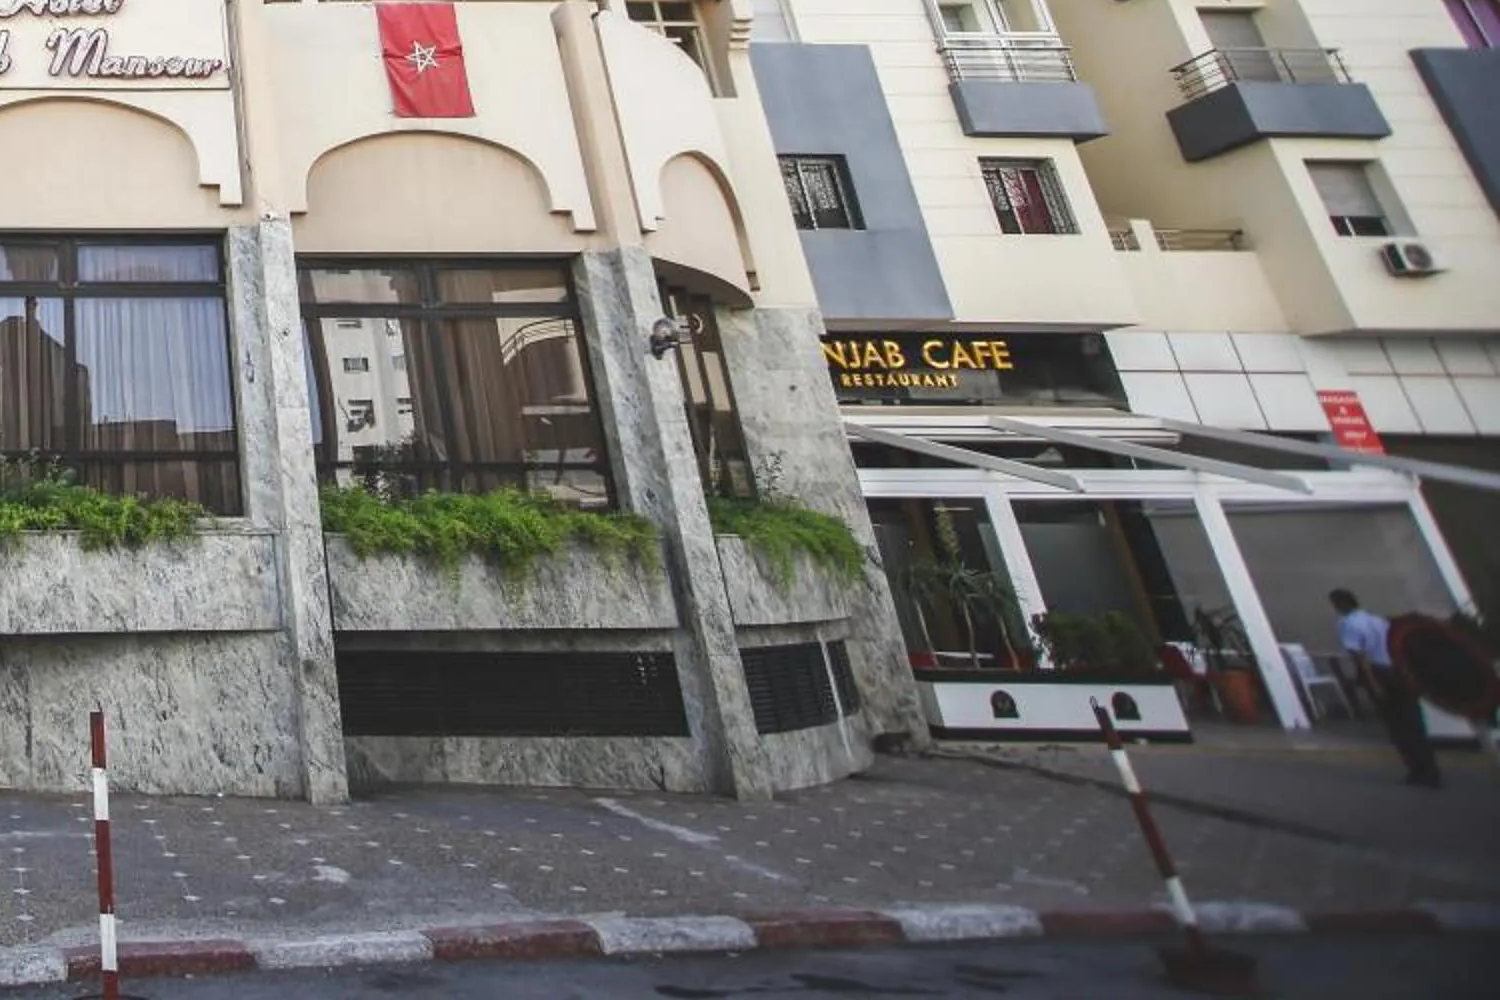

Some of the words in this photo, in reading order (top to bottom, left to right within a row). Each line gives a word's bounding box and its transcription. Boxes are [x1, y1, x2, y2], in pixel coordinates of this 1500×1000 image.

[45, 27, 228, 79] Mansour
[922, 340, 1014, 369] CAFE
[841, 373, 957, 388] RESTAURANT
